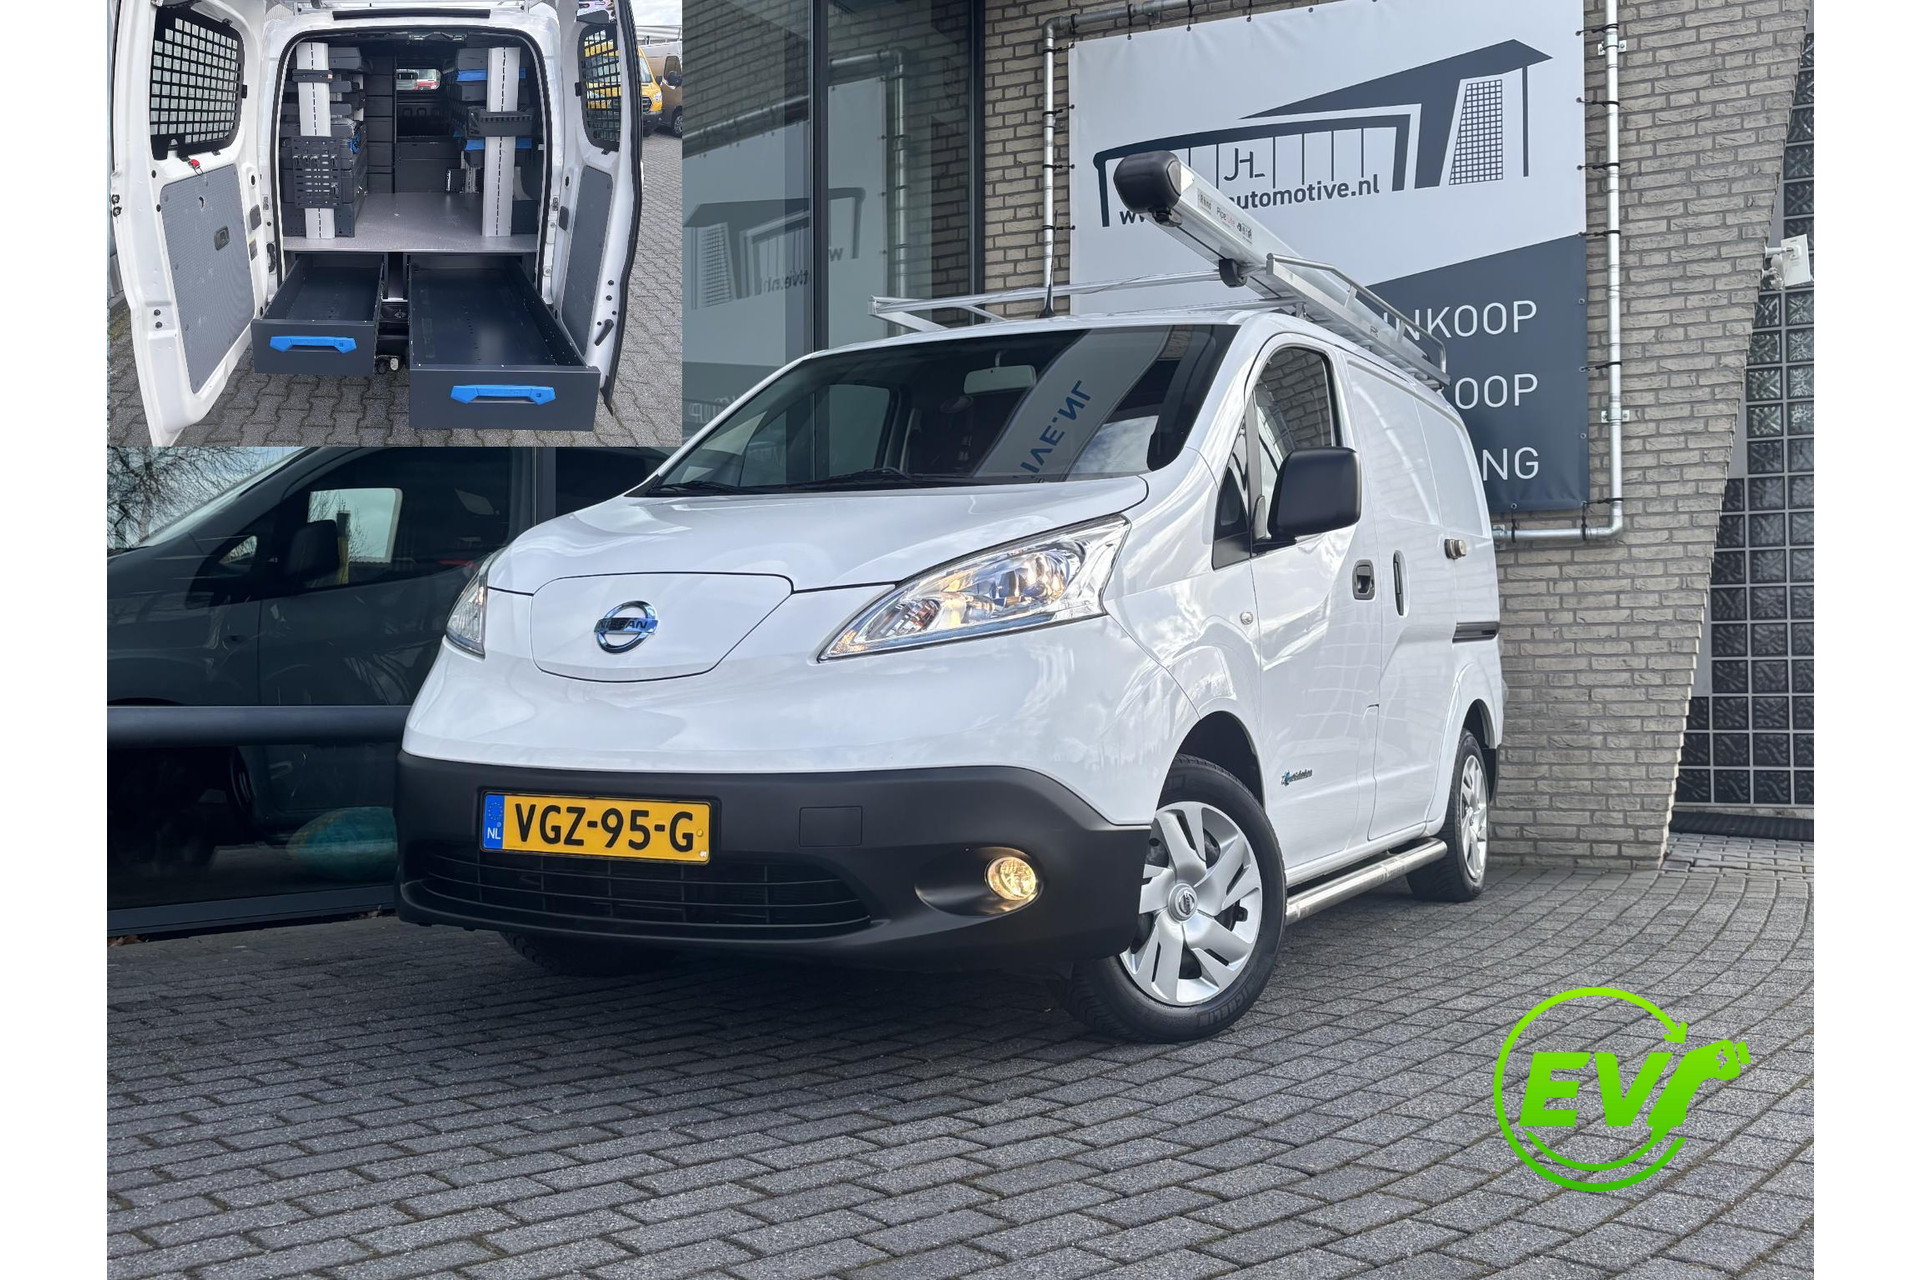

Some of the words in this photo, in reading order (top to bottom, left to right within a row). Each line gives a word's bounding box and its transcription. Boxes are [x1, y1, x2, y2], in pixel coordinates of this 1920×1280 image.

[1454, 373, 1538, 410] OOP
[1482, 446, 1539, 481] NG
[487, 828, 502, 840] NL
[515, 803, 694, 853] VGZ-95-G
